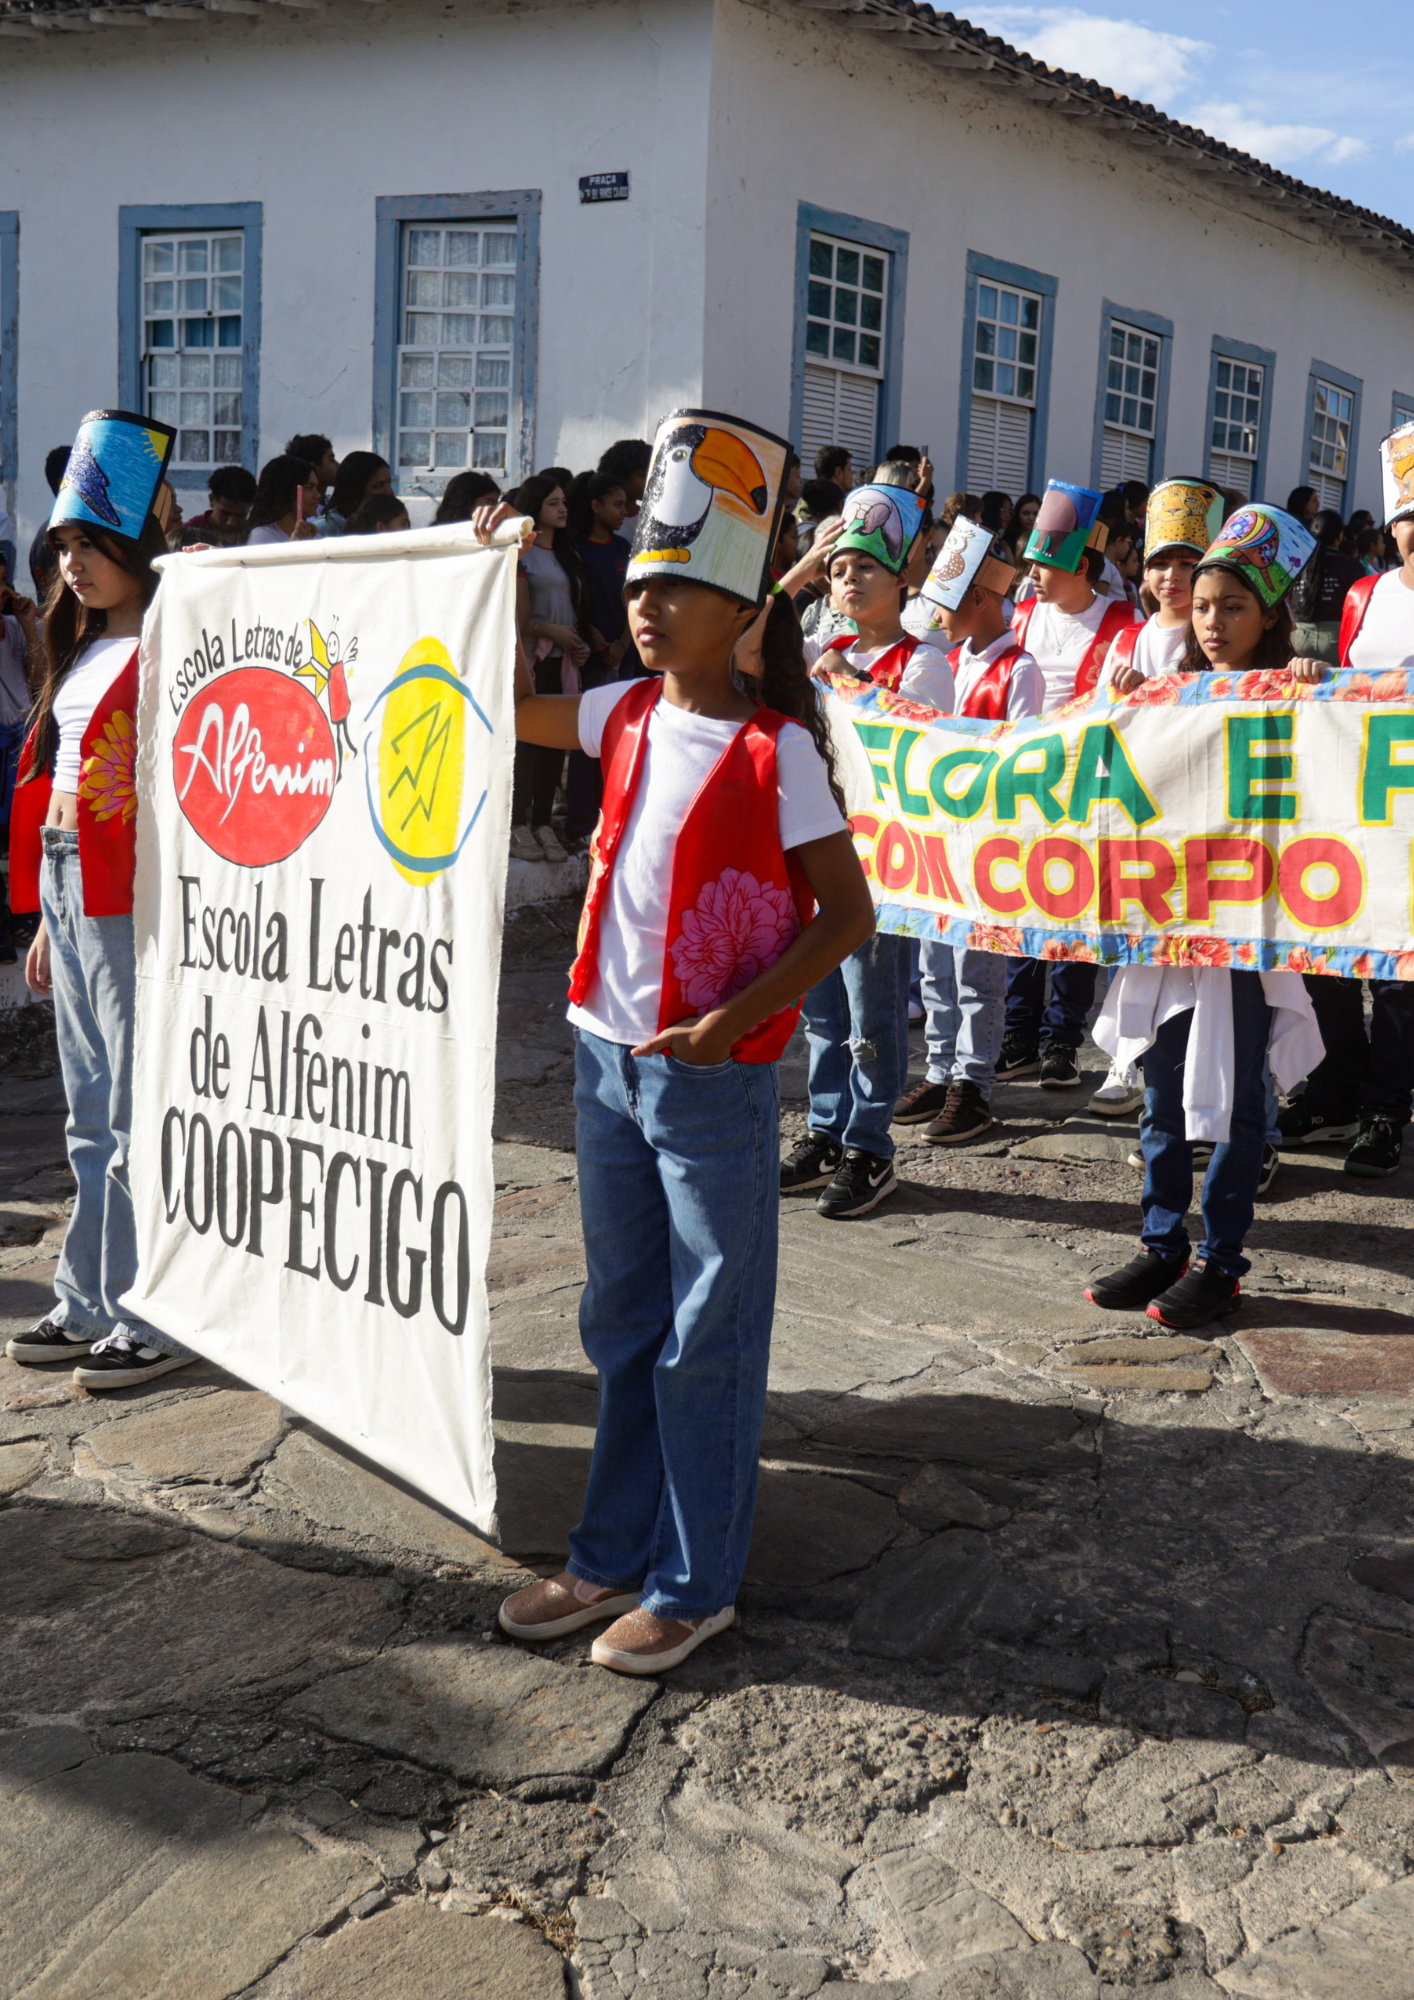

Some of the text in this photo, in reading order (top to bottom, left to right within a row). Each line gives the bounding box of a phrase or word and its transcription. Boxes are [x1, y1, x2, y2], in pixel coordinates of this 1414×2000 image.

[589, 175, 617, 185] PRAÇA
[169, 614, 303, 717] Escola Letras de
[180, 702, 334, 827] Alfenim
[852, 719, 1162, 829] FLORA
[1222, 709, 1300, 826] E
[846, 810, 967, 909] COM
[972, 831, 1369, 934] CORPO
[178, 875, 455, 1014] Escola Letras
[190, 995, 413, 1149] de Alfenim
[161, 1106, 470, 1337] COOPECIGO
